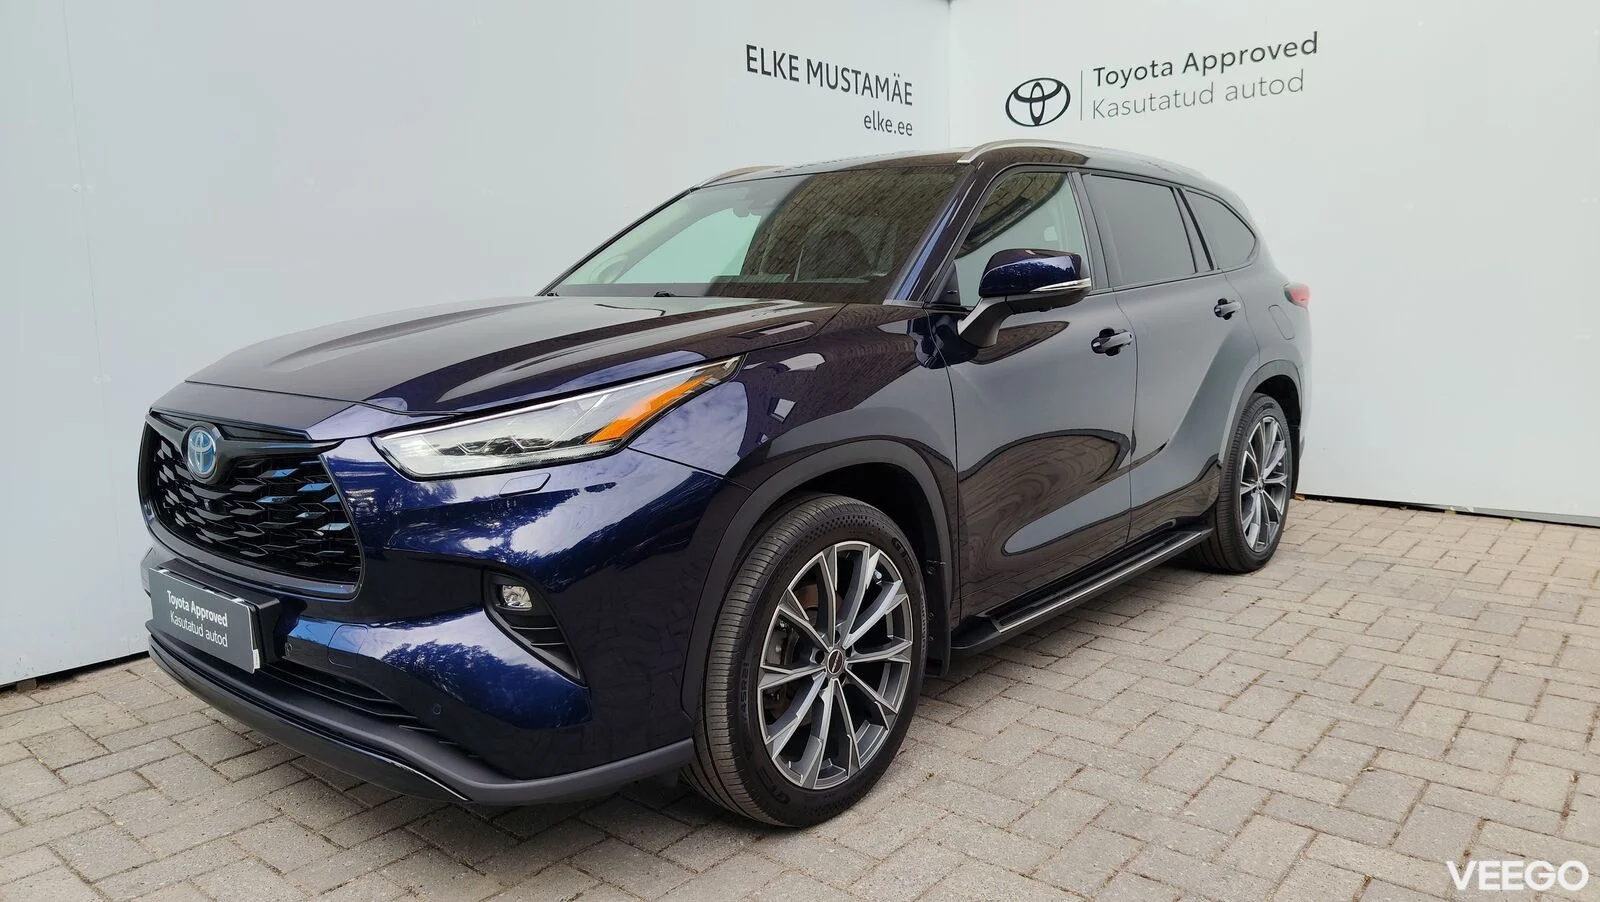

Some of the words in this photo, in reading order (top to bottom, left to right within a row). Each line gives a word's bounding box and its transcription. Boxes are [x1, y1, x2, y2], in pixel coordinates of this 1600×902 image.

[746, 44, 800, 82] ELKE
[806, 58, 913, 106] MUSTAMÄE
[1093, 60, 1173, 88] Toyota
[1182, 31, 1318, 76] Approved
[1092, 82, 1214, 119] Kasutatud
[1225, 68, 1304, 102] autod
[863, 109, 913, 136] elke.ee
[166, 590, 189, 611] Toyota
[190, 600, 228, 627] Approved
[169, 610, 204, 637] Kasutatud
[205, 629, 228, 648] autod
